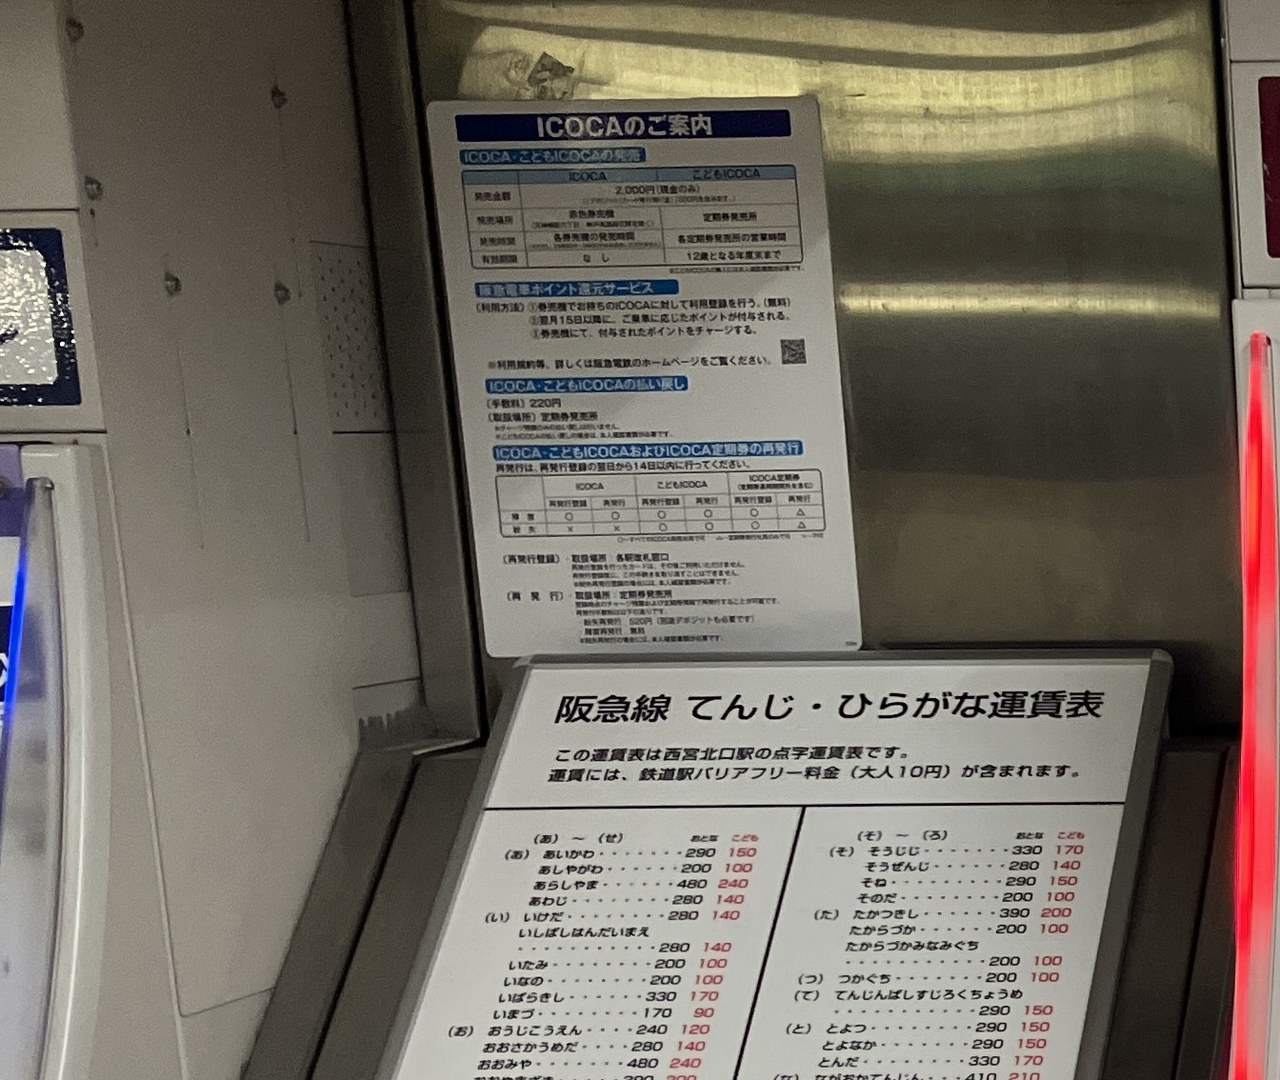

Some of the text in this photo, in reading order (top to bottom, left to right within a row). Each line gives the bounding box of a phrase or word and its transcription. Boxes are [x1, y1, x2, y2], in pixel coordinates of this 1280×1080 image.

[536, 114, 714, 139] ICOCAのご案内
[553, 694, 671, 724] 阪急線
[555, 745, 910, 763] この運賃表は西宮北口駅の点字運賃表です。
[542, 847, 757, 860] あいかわ 290 150
[864, 860, 1081, 872] そうぜんじ 280 140
[533, 878, 749, 891] あらしやま 480 240
[482, 1039, 707, 1053] おおさかうめだ 280 140
